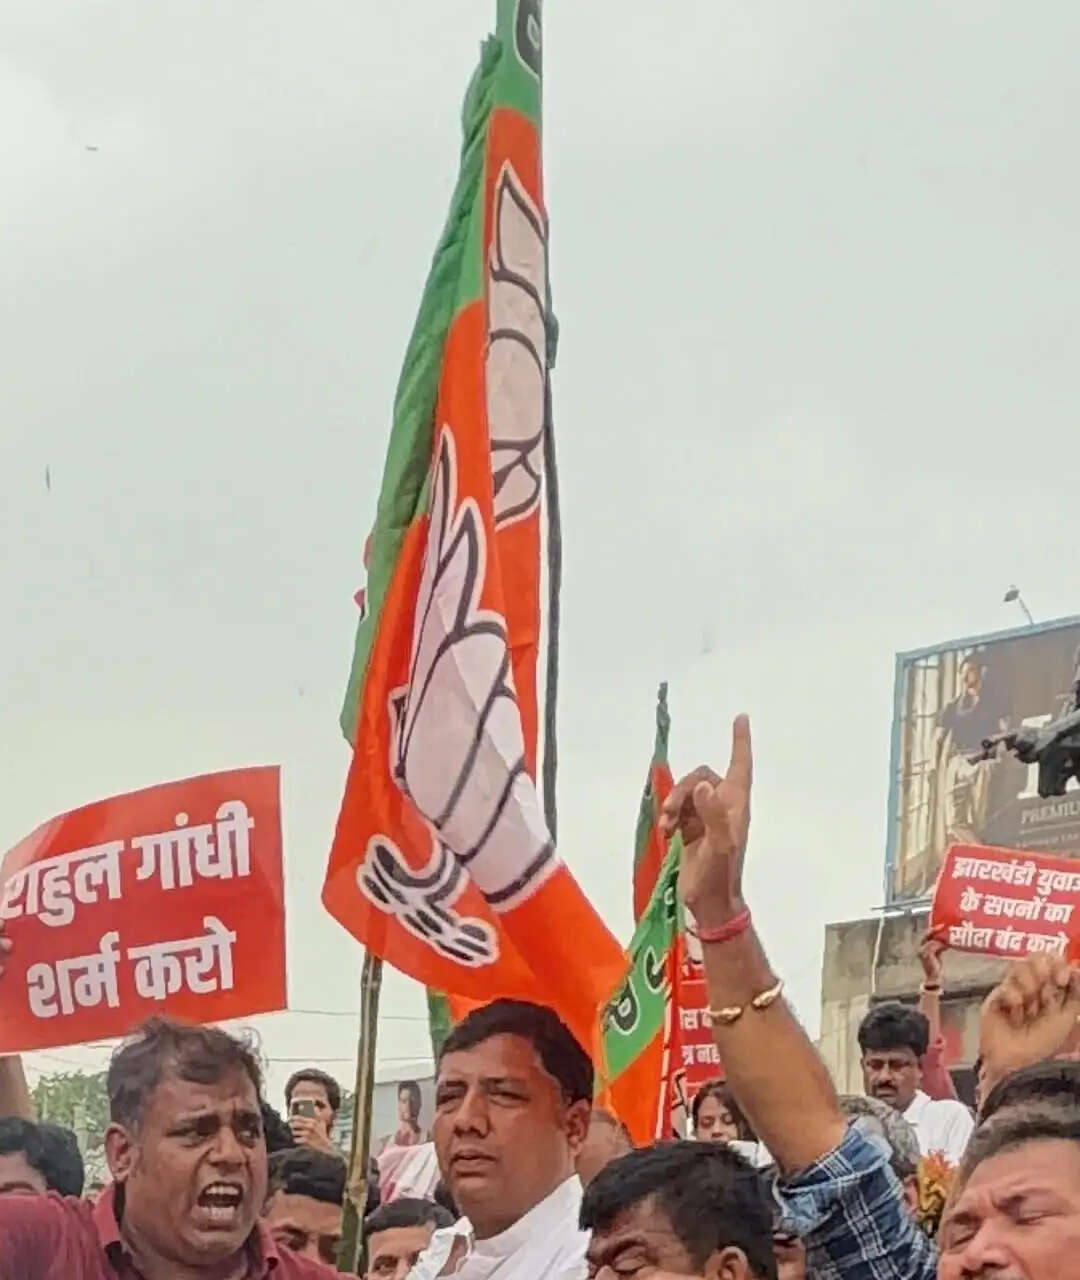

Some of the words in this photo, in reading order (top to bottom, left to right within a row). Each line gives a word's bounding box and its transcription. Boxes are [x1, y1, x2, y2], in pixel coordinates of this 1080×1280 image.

[0, 840, 124, 926] राहुल
[132, 800, 255, 889] गांधी
[960, 885, 983, 912] के
[983, 894, 1047, 920] सपनों
[1044, 903, 1074, 924] का
[27, 931, 120, 1018] शर्म
[128, 916, 236, 999] करो
